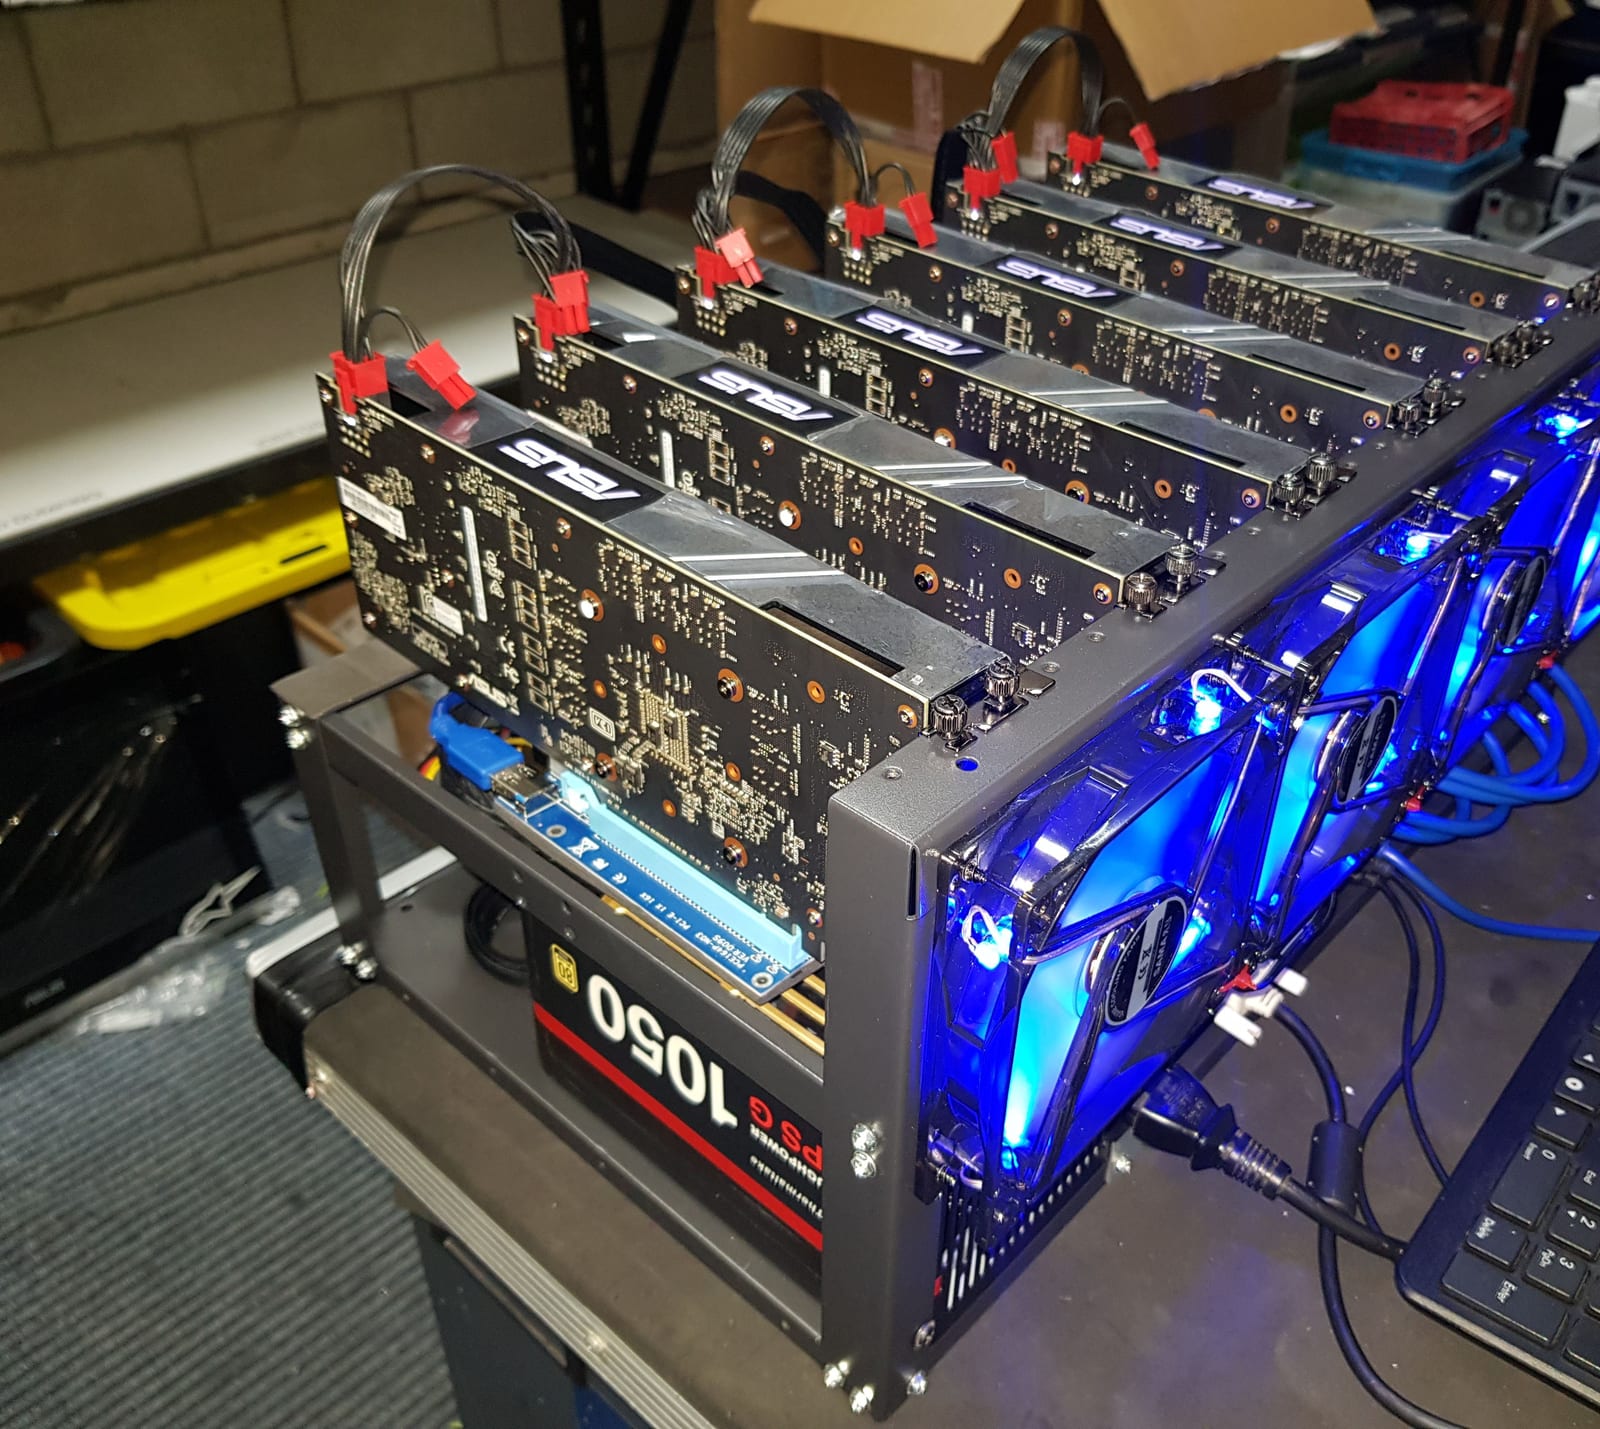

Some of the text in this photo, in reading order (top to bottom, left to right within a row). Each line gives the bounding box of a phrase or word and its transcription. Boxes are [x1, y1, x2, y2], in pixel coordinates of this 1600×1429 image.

[1110, 216, 1226, 250] ASUS
[997, 257, 1118, 298] ASUS
[856, 310, 984, 356] ASUS
[698, 369, 834, 421] ASUS
[498, 438, 641, 500] ASUS
[588, 974, 738, 1130] 1050
[750, 1155, 823, 1218] Thermaltake
[1580, 1216, 1597, 1229] 2
[1559, 1256, 1576, 1270] 3
